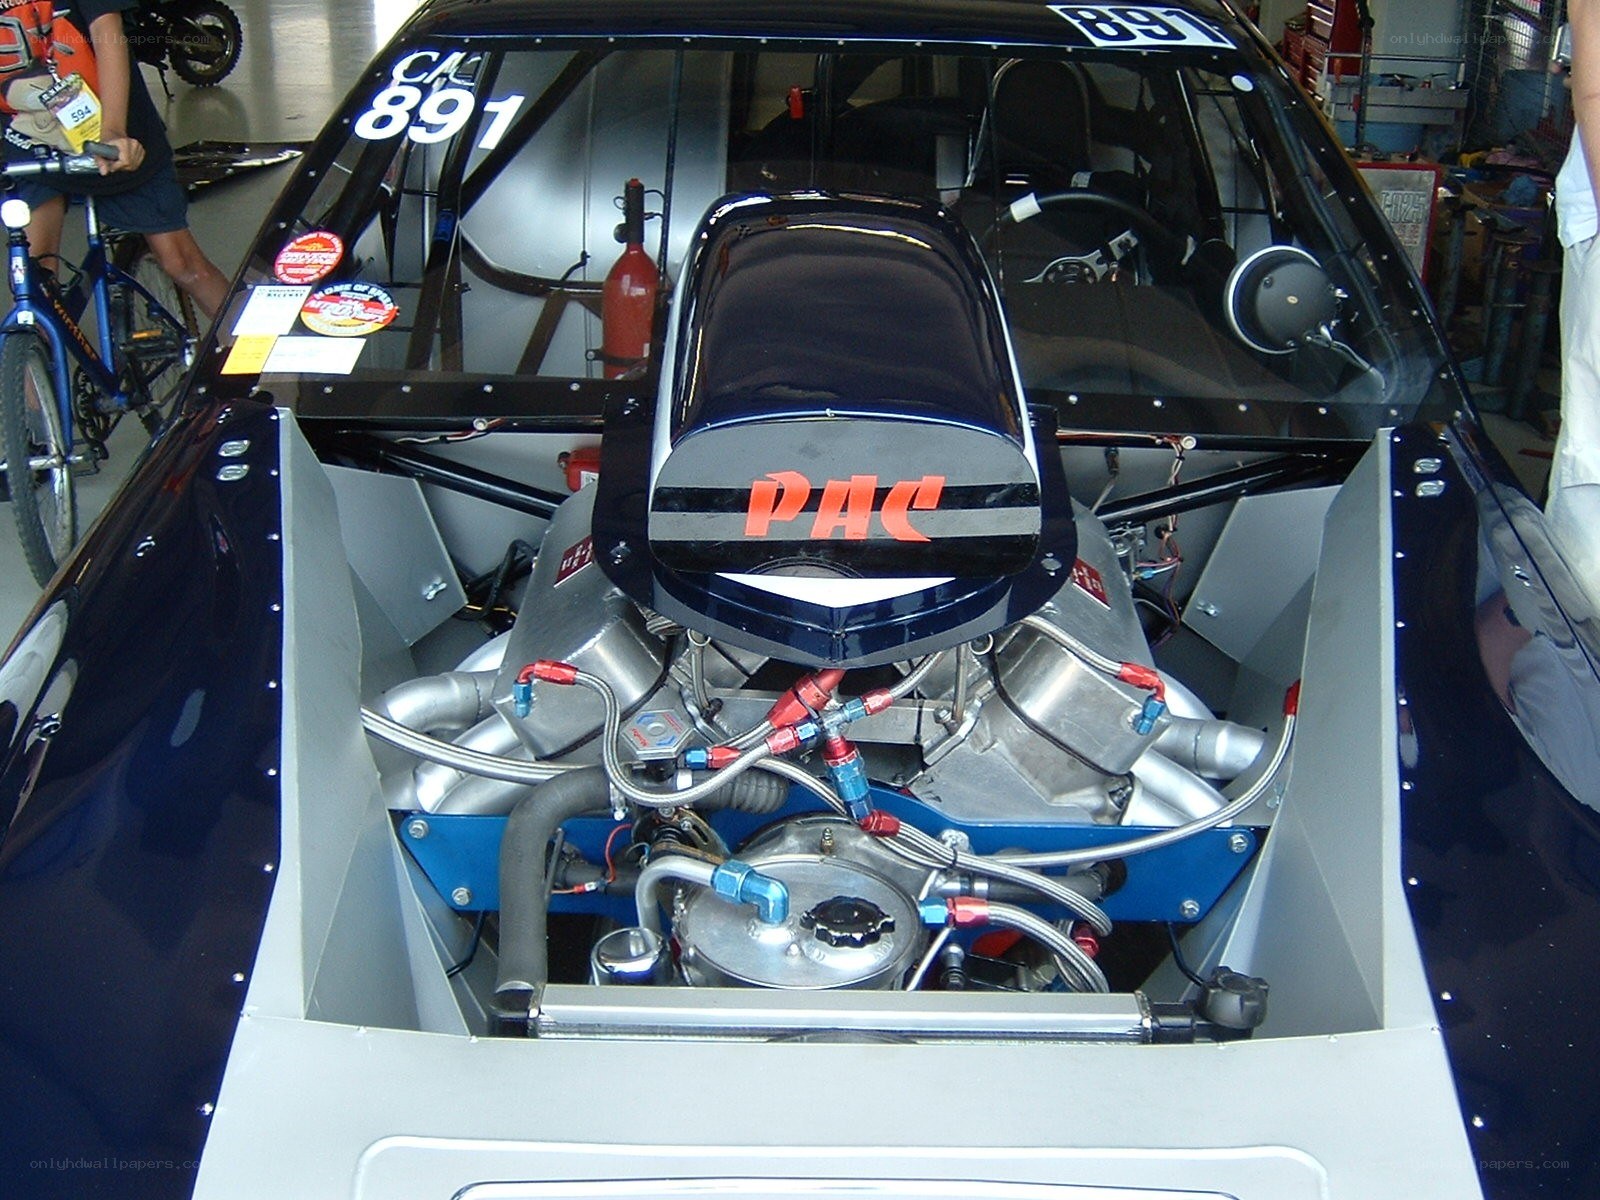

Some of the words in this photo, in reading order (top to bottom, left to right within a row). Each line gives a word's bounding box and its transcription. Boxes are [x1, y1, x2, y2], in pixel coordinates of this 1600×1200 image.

[1060, 7, 1229, 44] 891
[71, 105, 91, 122] 594
[354, 84, 525, 150] 891
[353, 284, 369, 292] OF
[744, 471, 945, 542] PAC
